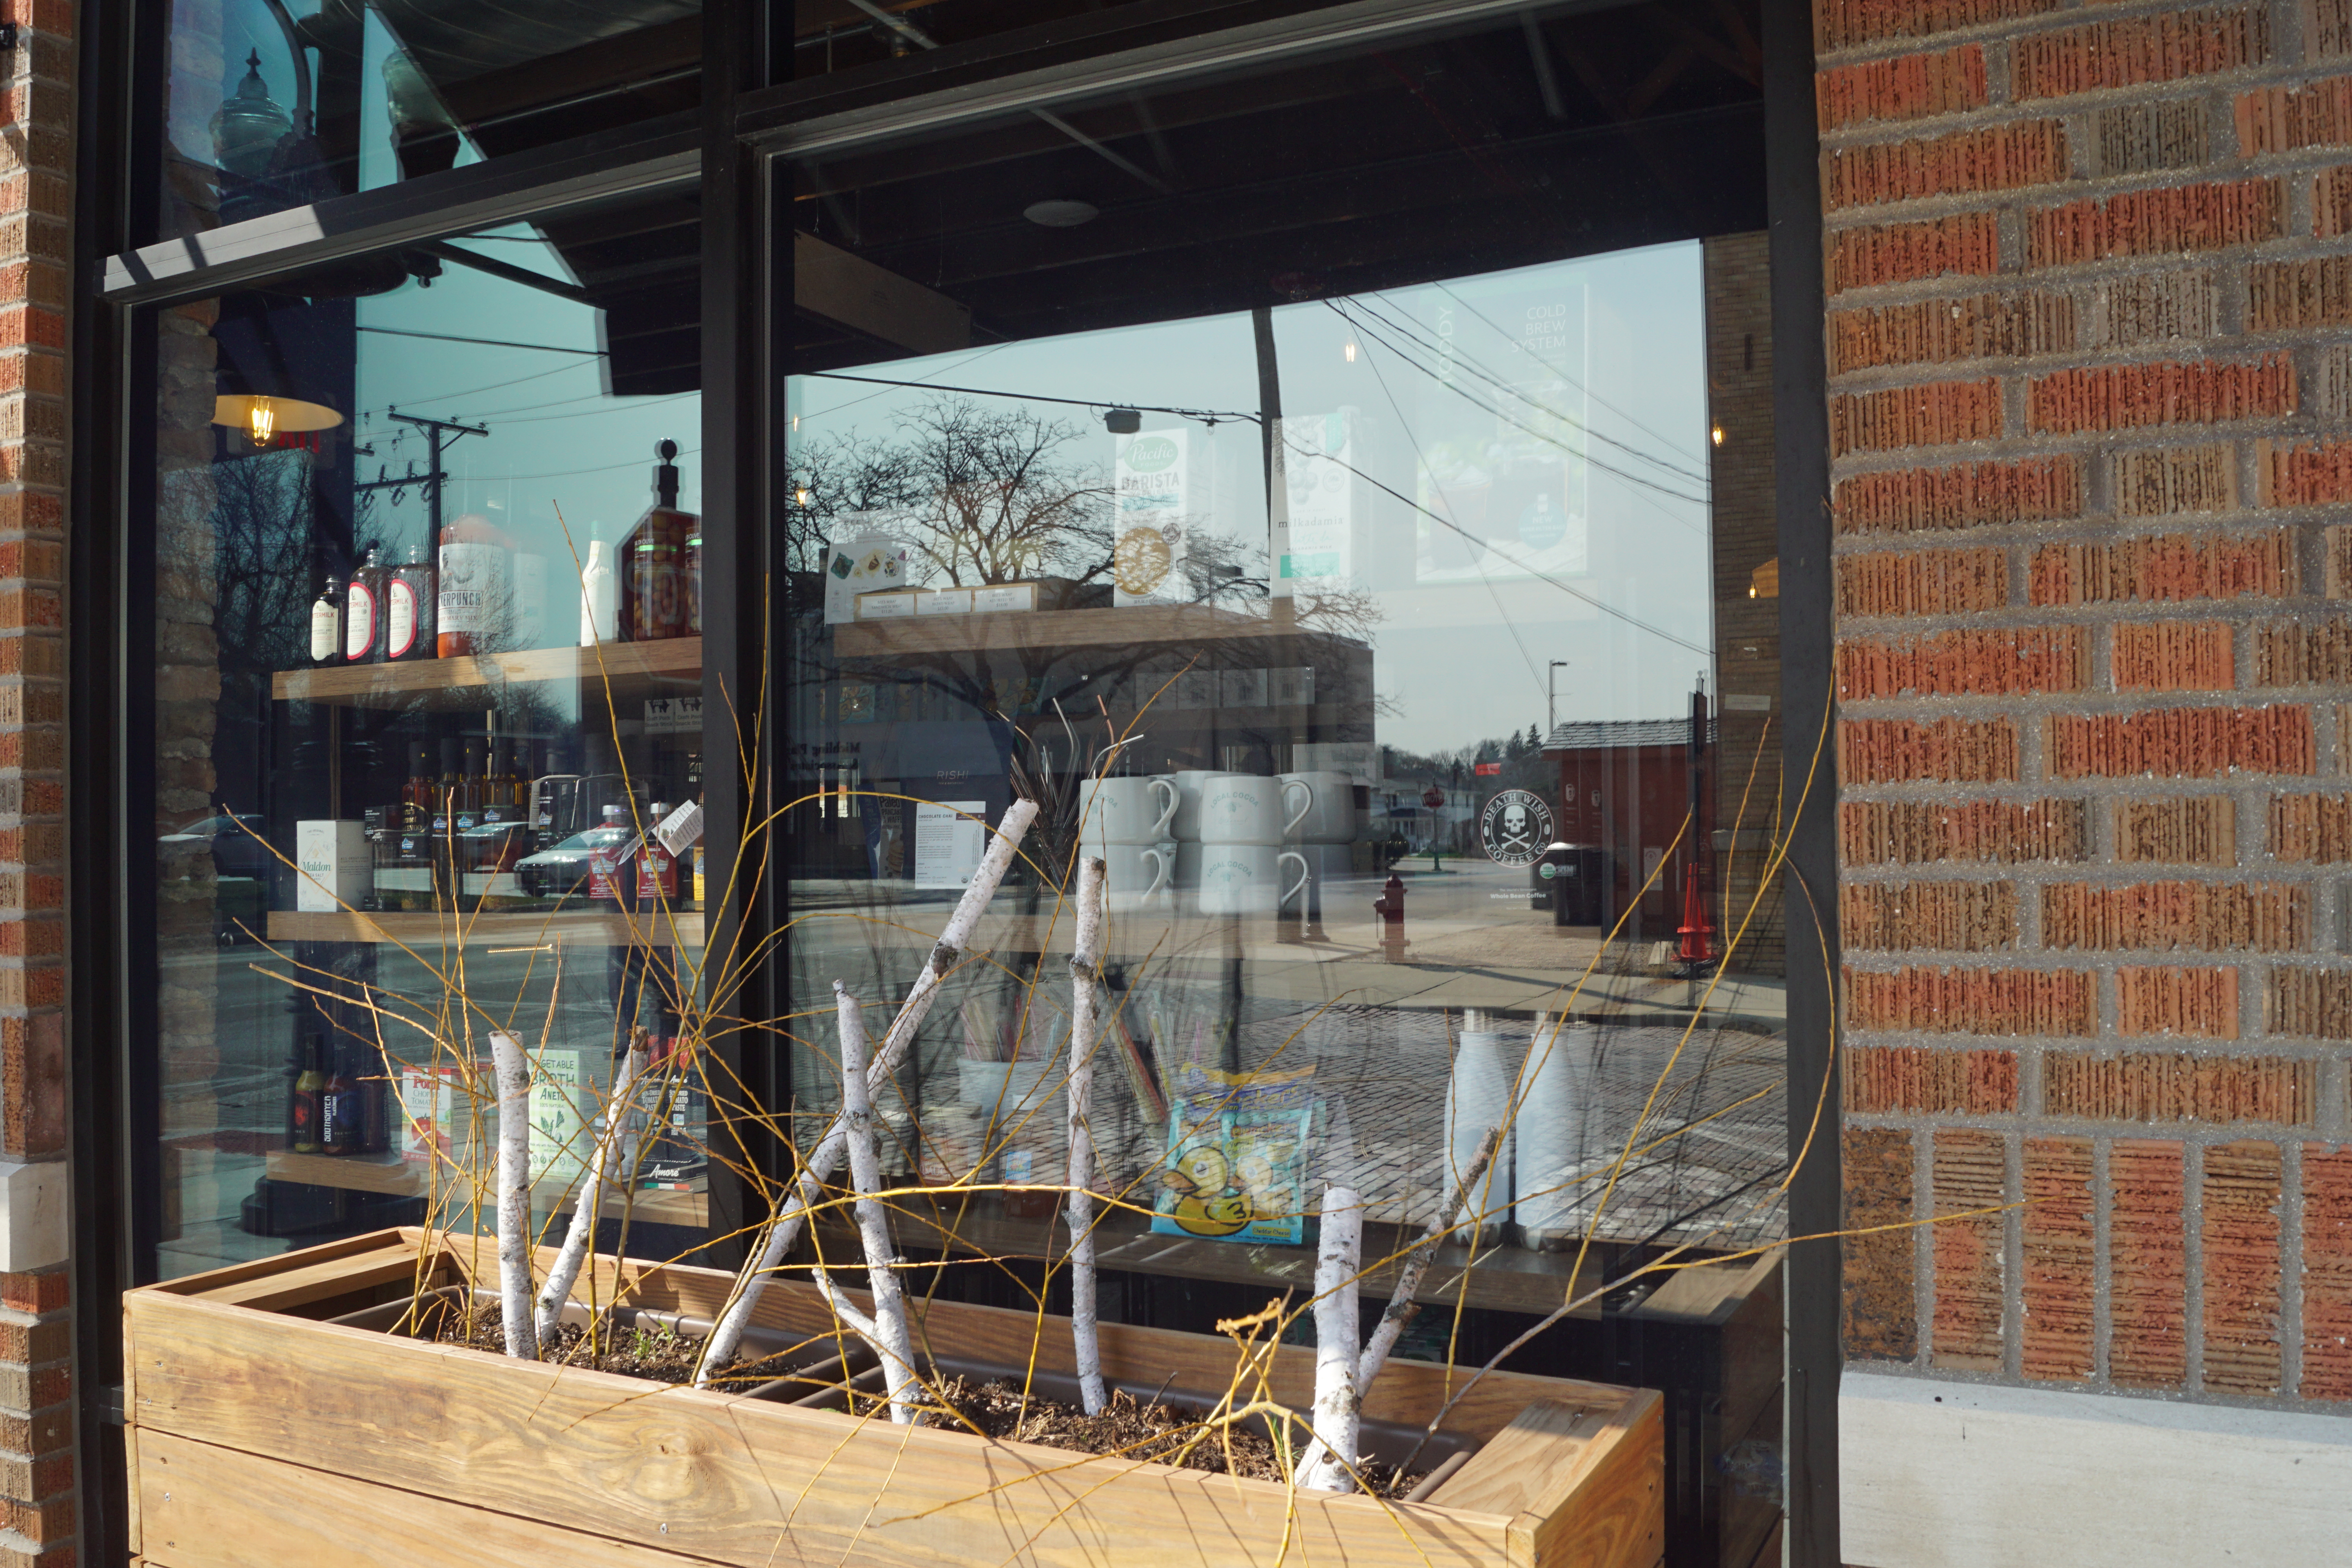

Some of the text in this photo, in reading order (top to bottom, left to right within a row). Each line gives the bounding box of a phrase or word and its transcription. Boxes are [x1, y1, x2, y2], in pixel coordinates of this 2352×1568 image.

[1527, 304, 1566, 319] COLD
[1526, 319, 1566, 335] BREW
[1439, 306, 1452, 388] TODDY
[1512, 335, 1565, 352] SYSTEM
[1130, 443, 1174, 463] Pacific
[1122, 472, 1180, 490] BARISTA
[1278, 515, 1343, 528] milkadamia
[1532, 515, 1552, 524] NEW
[937, 771, 969, 780] RISHI
[880, 796, 901, 808] Paleo
[1095, 793, 1118, 808] COCOA
[1211, 791, 1258, 809] LOCAL COCOA
[1485, 793, 1549, 822] DEATH WISH
[1488, 844, 1534, 865] COFFEE
[303, 862, 331, 871] Maldon
[1207, 860, 1252, 878] LOCAL COCOA
[531, 1072, 574, 1087] BROTH
[412, 1097, 442, 1107] TOMATES
[669, 1096, 688, 1104] TMATO
